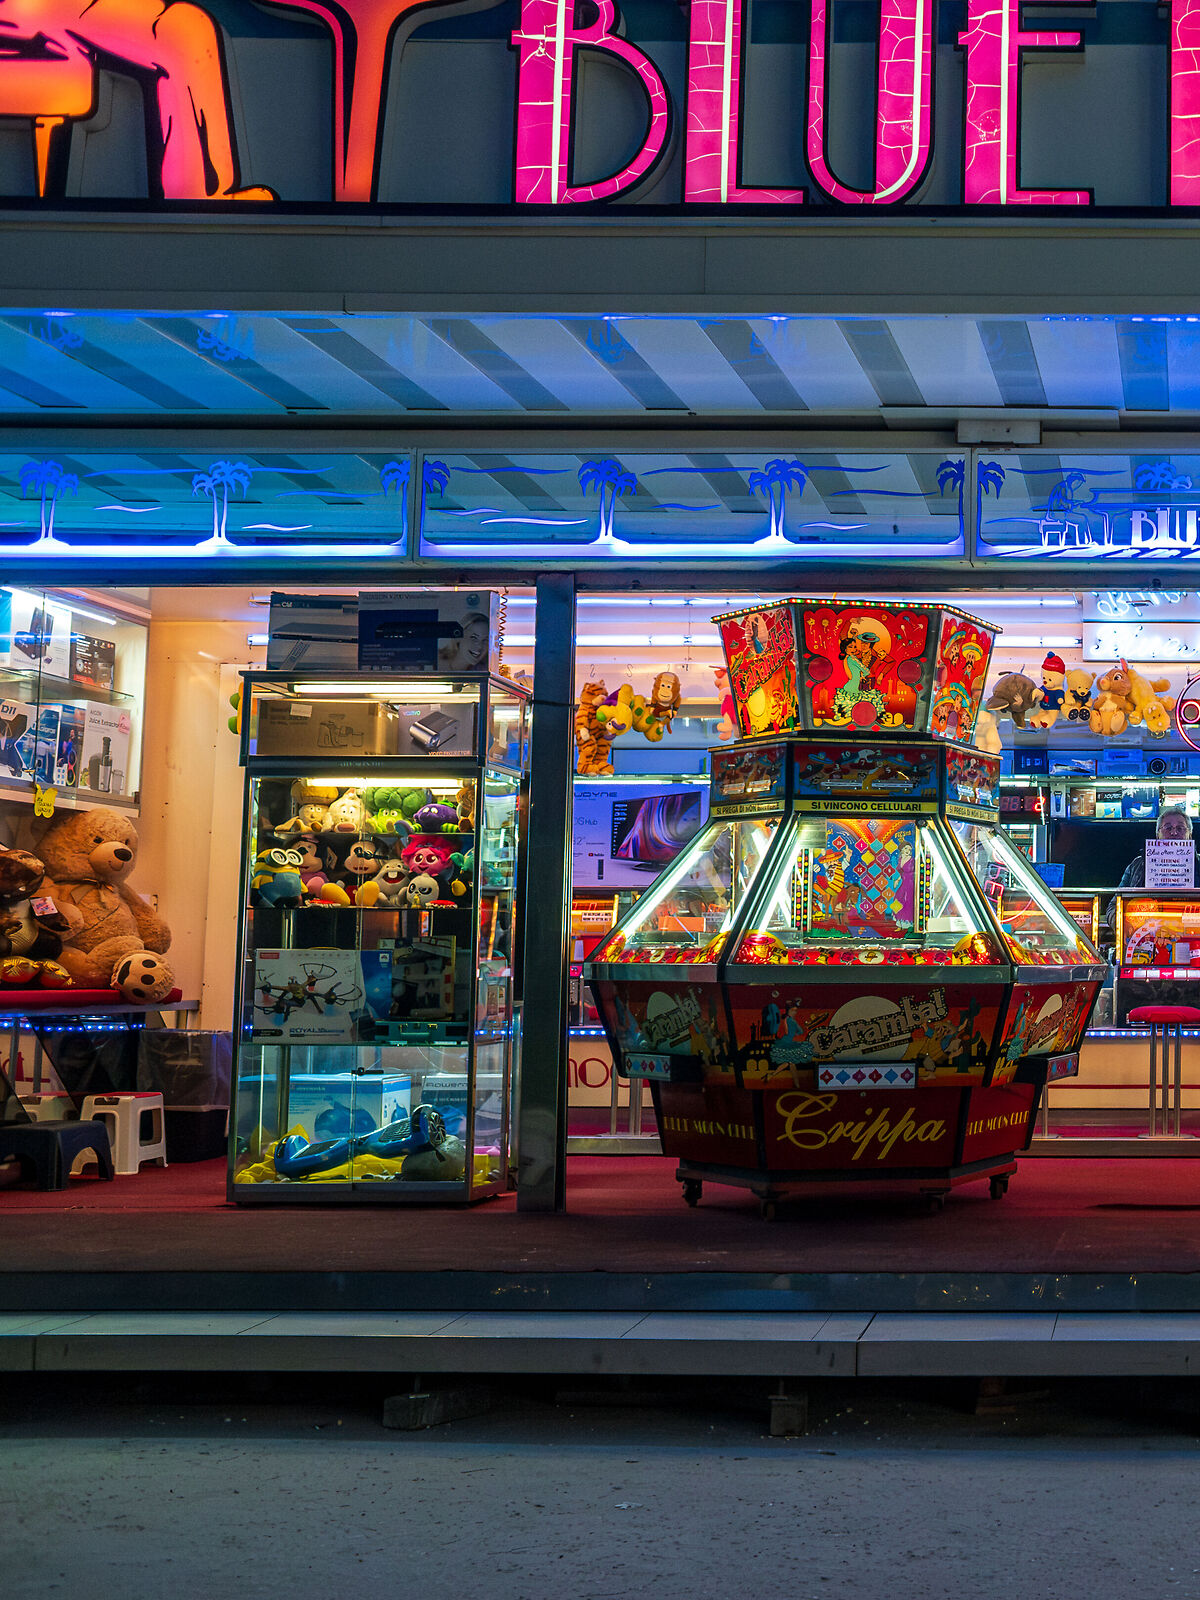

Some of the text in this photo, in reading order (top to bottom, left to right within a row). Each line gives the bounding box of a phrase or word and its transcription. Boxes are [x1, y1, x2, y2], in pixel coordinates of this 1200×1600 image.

[511, 0, 1096, 206] BLUE
[811, 801, 922, 812] SI VINCONO CELLULARI
[807, 986, 949, 1059] Caramba!
[776, 1091, 947, 1161] Crippa
